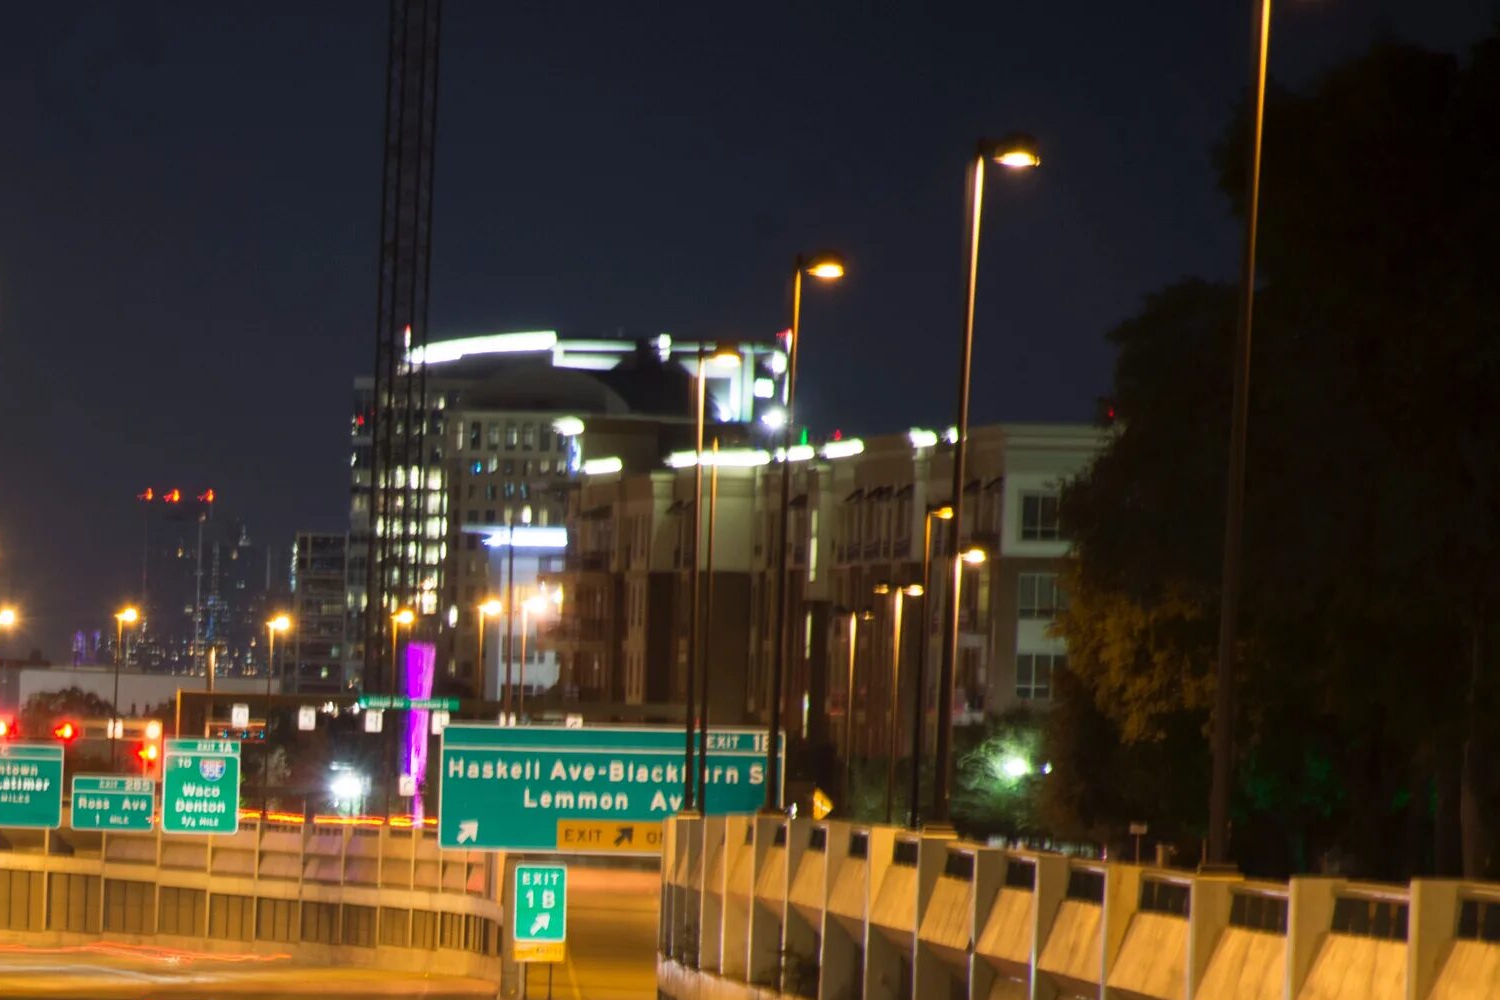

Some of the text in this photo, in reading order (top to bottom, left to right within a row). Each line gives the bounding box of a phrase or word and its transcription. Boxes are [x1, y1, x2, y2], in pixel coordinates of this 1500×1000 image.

[219, 740, 233, 753] 1A
[706, 734, 740, 750] EXIT
[178, 758, 192, 769] TO
[448, 757, 766, 785] Haskell Ave-Blackrn S
[182, 782, 220, 798] Waco
[1, 793, 30, 804] MILES
[78, 796, 147, 811] Ross Ave
[175, 797, 226, 813] Denton
[524, 787, 696, 812] Lemmon Av
[199, 816, 219, 827] MILE
[564, 829, 603, 843] EXIT
[522, 871, 560, 886] EXIT
